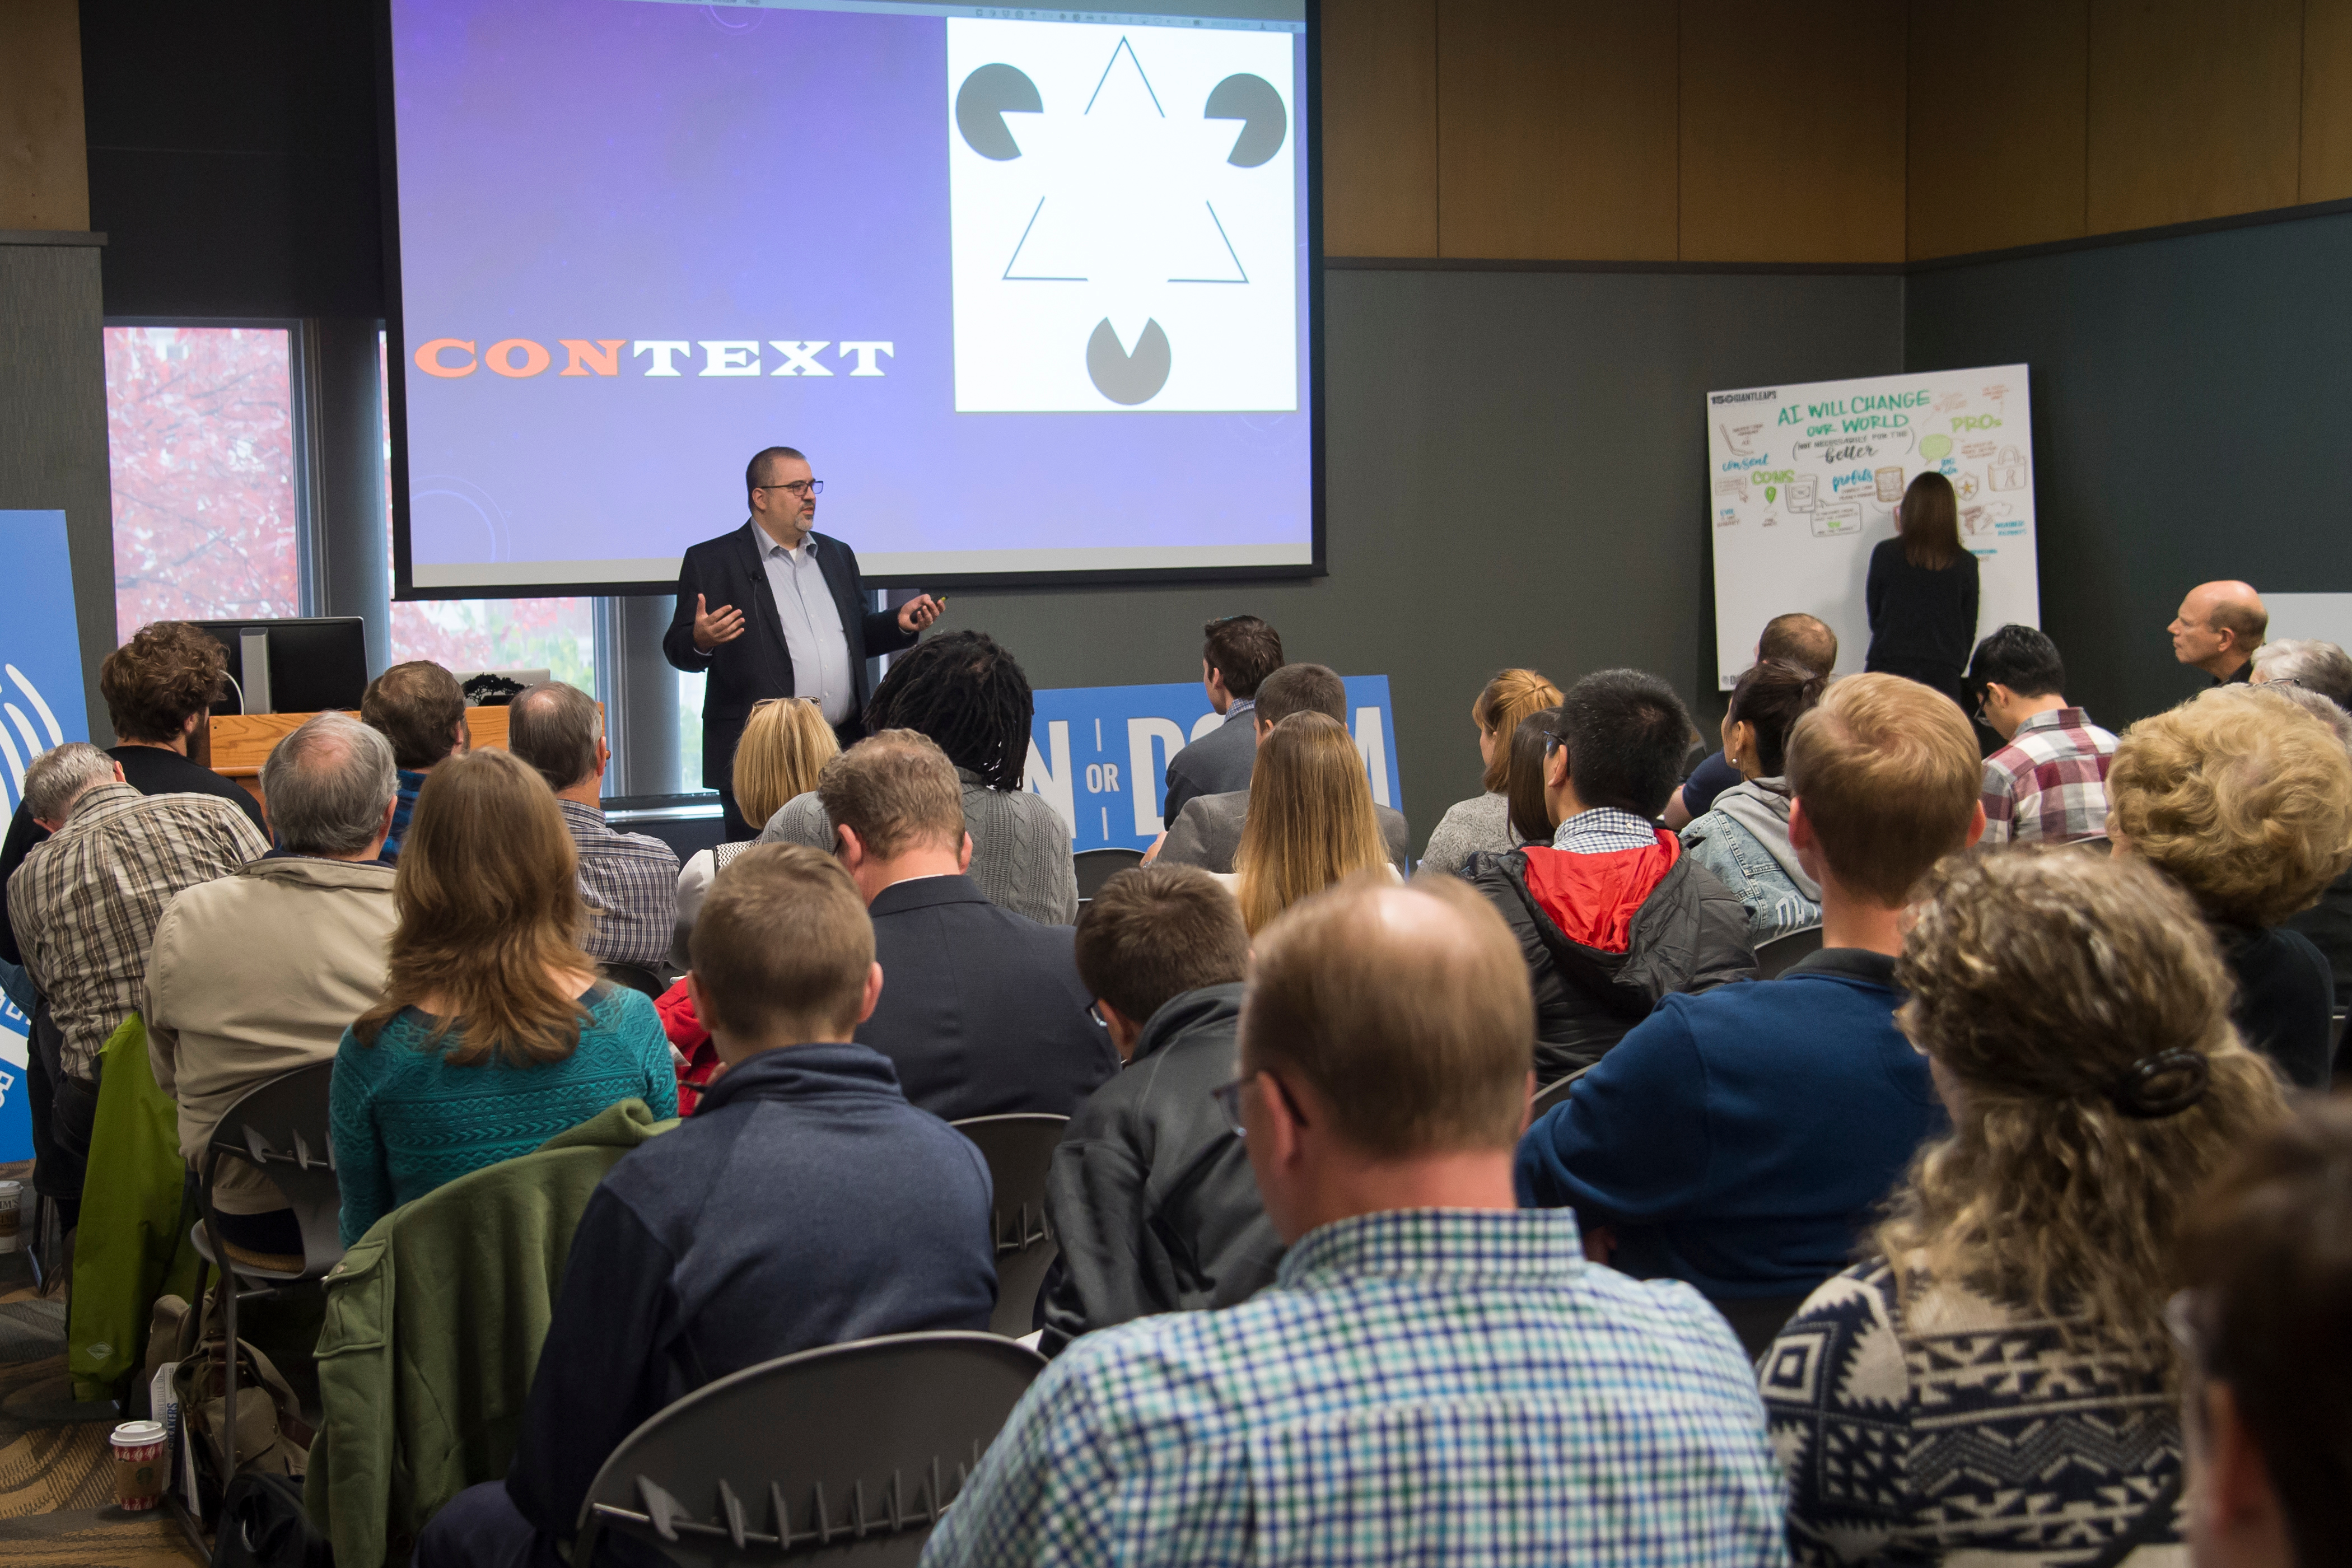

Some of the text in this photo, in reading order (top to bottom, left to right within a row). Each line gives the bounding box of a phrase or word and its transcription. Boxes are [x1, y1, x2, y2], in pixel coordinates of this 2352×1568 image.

[414, 338, 894, 377] CONTEXT
[1778, 390, 1930, 426] AI WILL CHANGE
[1807, 414, 1909, 437] OUR WORLD
[1751, 469, 1795, 485] CONS
[1086, 763, 1119, 794] OR
